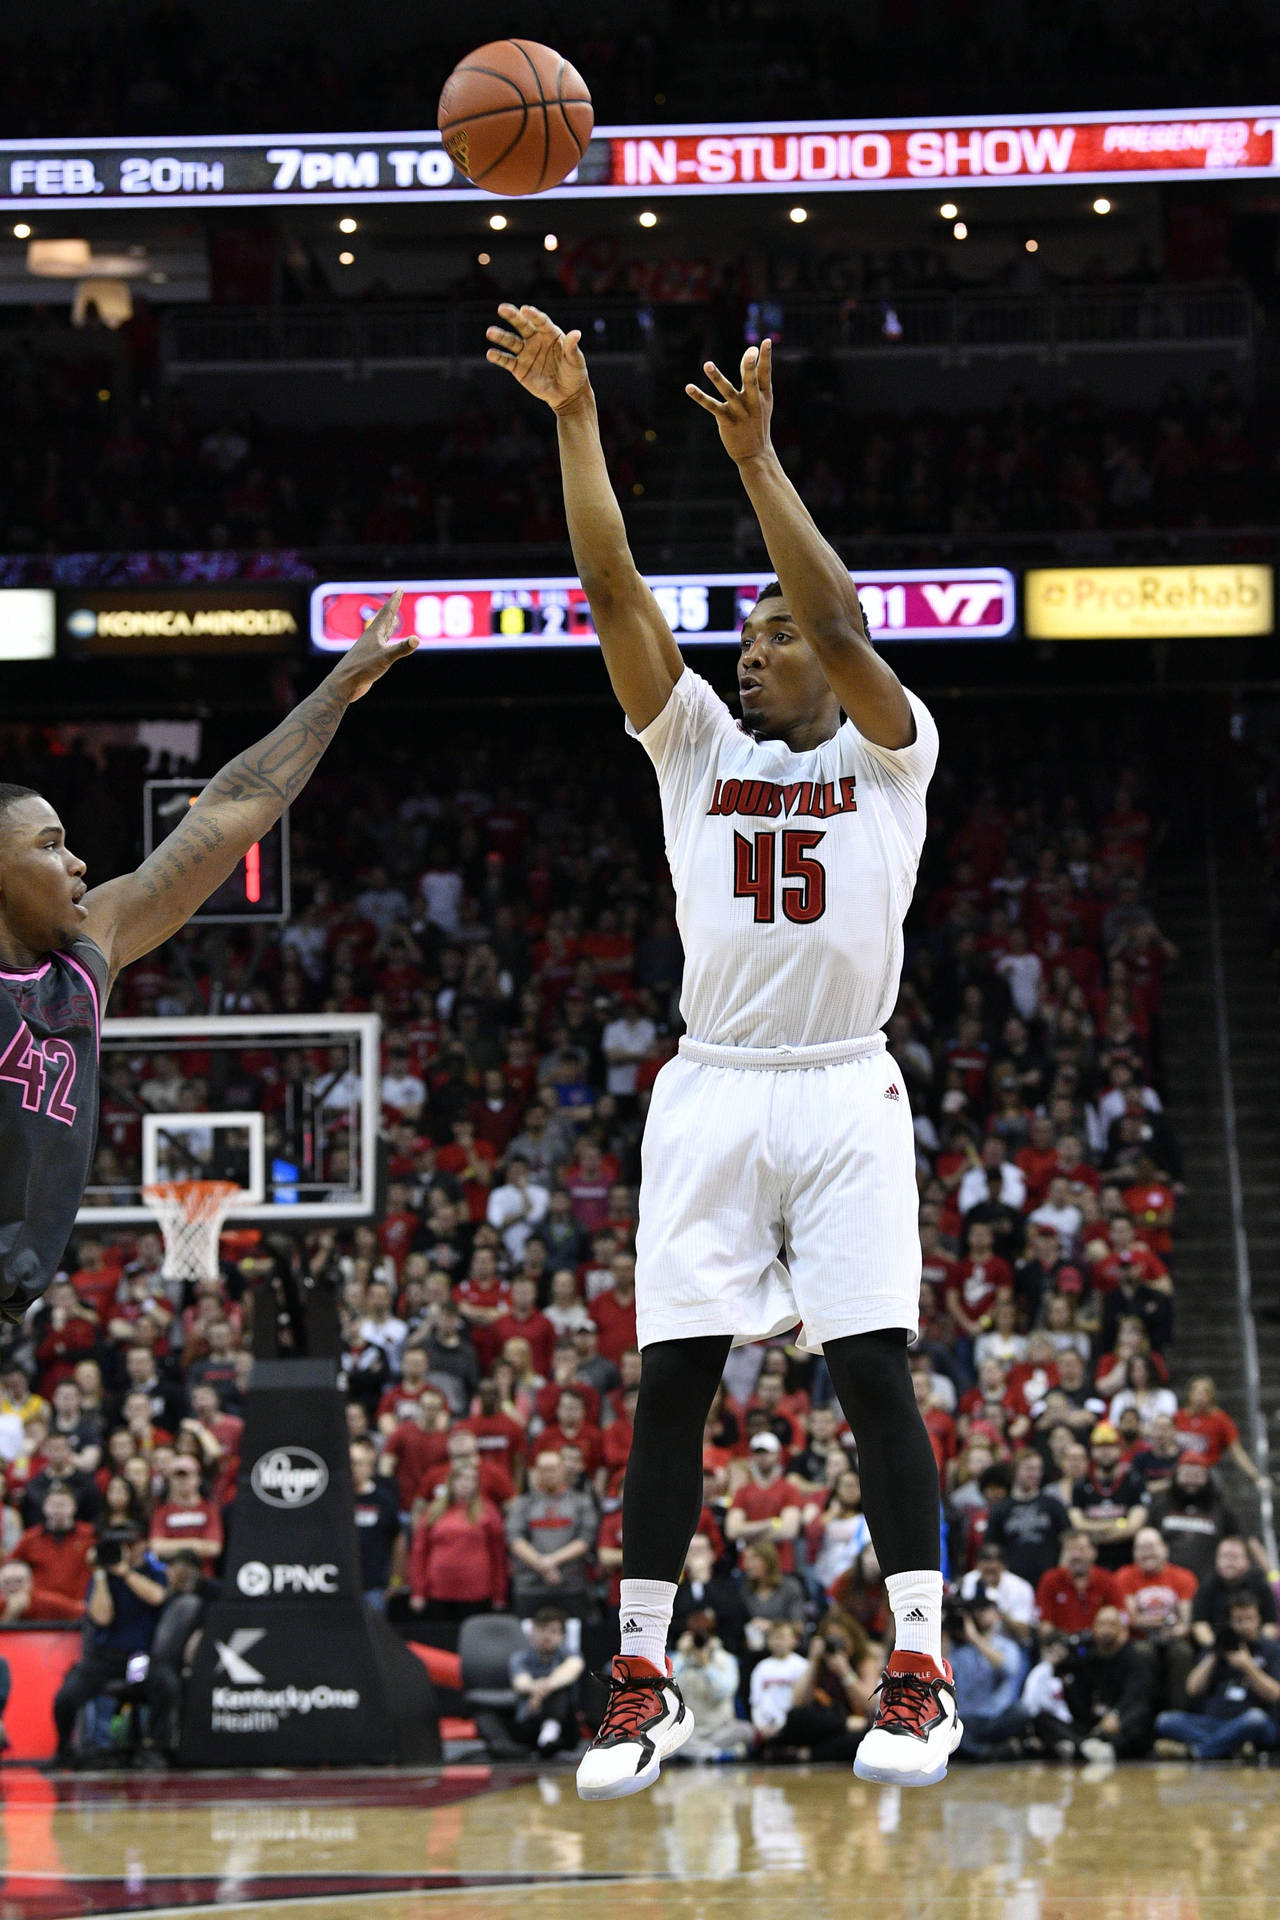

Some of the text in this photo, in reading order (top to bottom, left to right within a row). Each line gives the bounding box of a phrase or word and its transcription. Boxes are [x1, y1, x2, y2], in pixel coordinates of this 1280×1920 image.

[10, 159, 104, 194] FEB.
[120, 157, 224, 193] 20TH
[266, 149, 379, 190] 7PM
[622, 127, 1077, 185] IN-STUDIO SHOW
[706, 775, 857, 820] LOUISVILLE
[733, 828, 827, 925] 45
[0, 1018, 77, 1128] 42
[273, 1563, 339, 1594] PNC
[903, 1614, 928, 1623] adidas
[211, 1710, 280, 1733] Health
[212, 1685, 360, 1715] KentuckyOne
